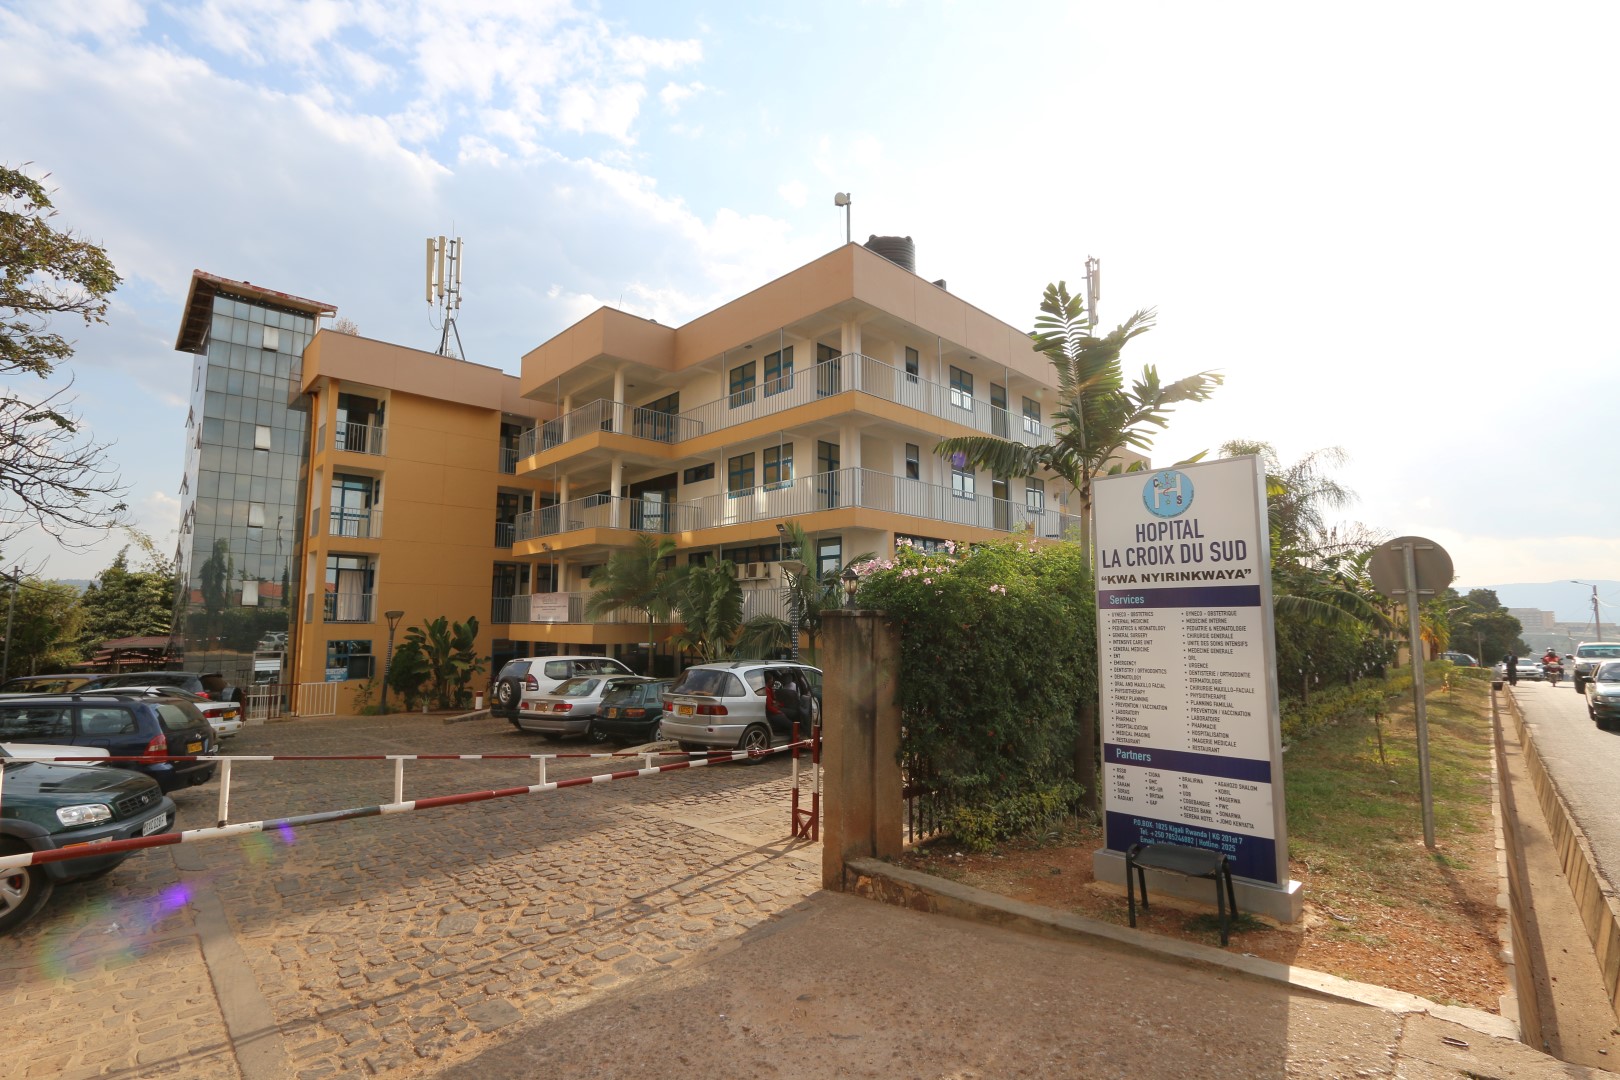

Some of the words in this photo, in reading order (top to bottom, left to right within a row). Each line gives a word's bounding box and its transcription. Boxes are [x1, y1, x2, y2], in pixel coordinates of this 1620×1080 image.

[1136, 518, 1204, 543] HOPITAL
[1102, 548, 1122, 568] LA
[1126, 544, 1175, 567] CROIX
[1180, 542, 1204, 564] DU
[1210, 540, 1246, 562] SUD
[1109, 594, 1145, 605] Services
[1192, 745, 1220, 753] RESTAURANT
[1116, 748, 1152, 762] Partners
[1183, 798, 1210, 807] COGEBANQUE
[1219, 811, 1242, 819] SONARWA
[1233, 820, 1254, 829] KENYATTA
[1169, 825, 1184, 833] Kigali
[1185, 828, 1207, 838] Rwanda
[1212, 832, 1220, 840] KG
[1221, 843, 1236, 852] 2025
